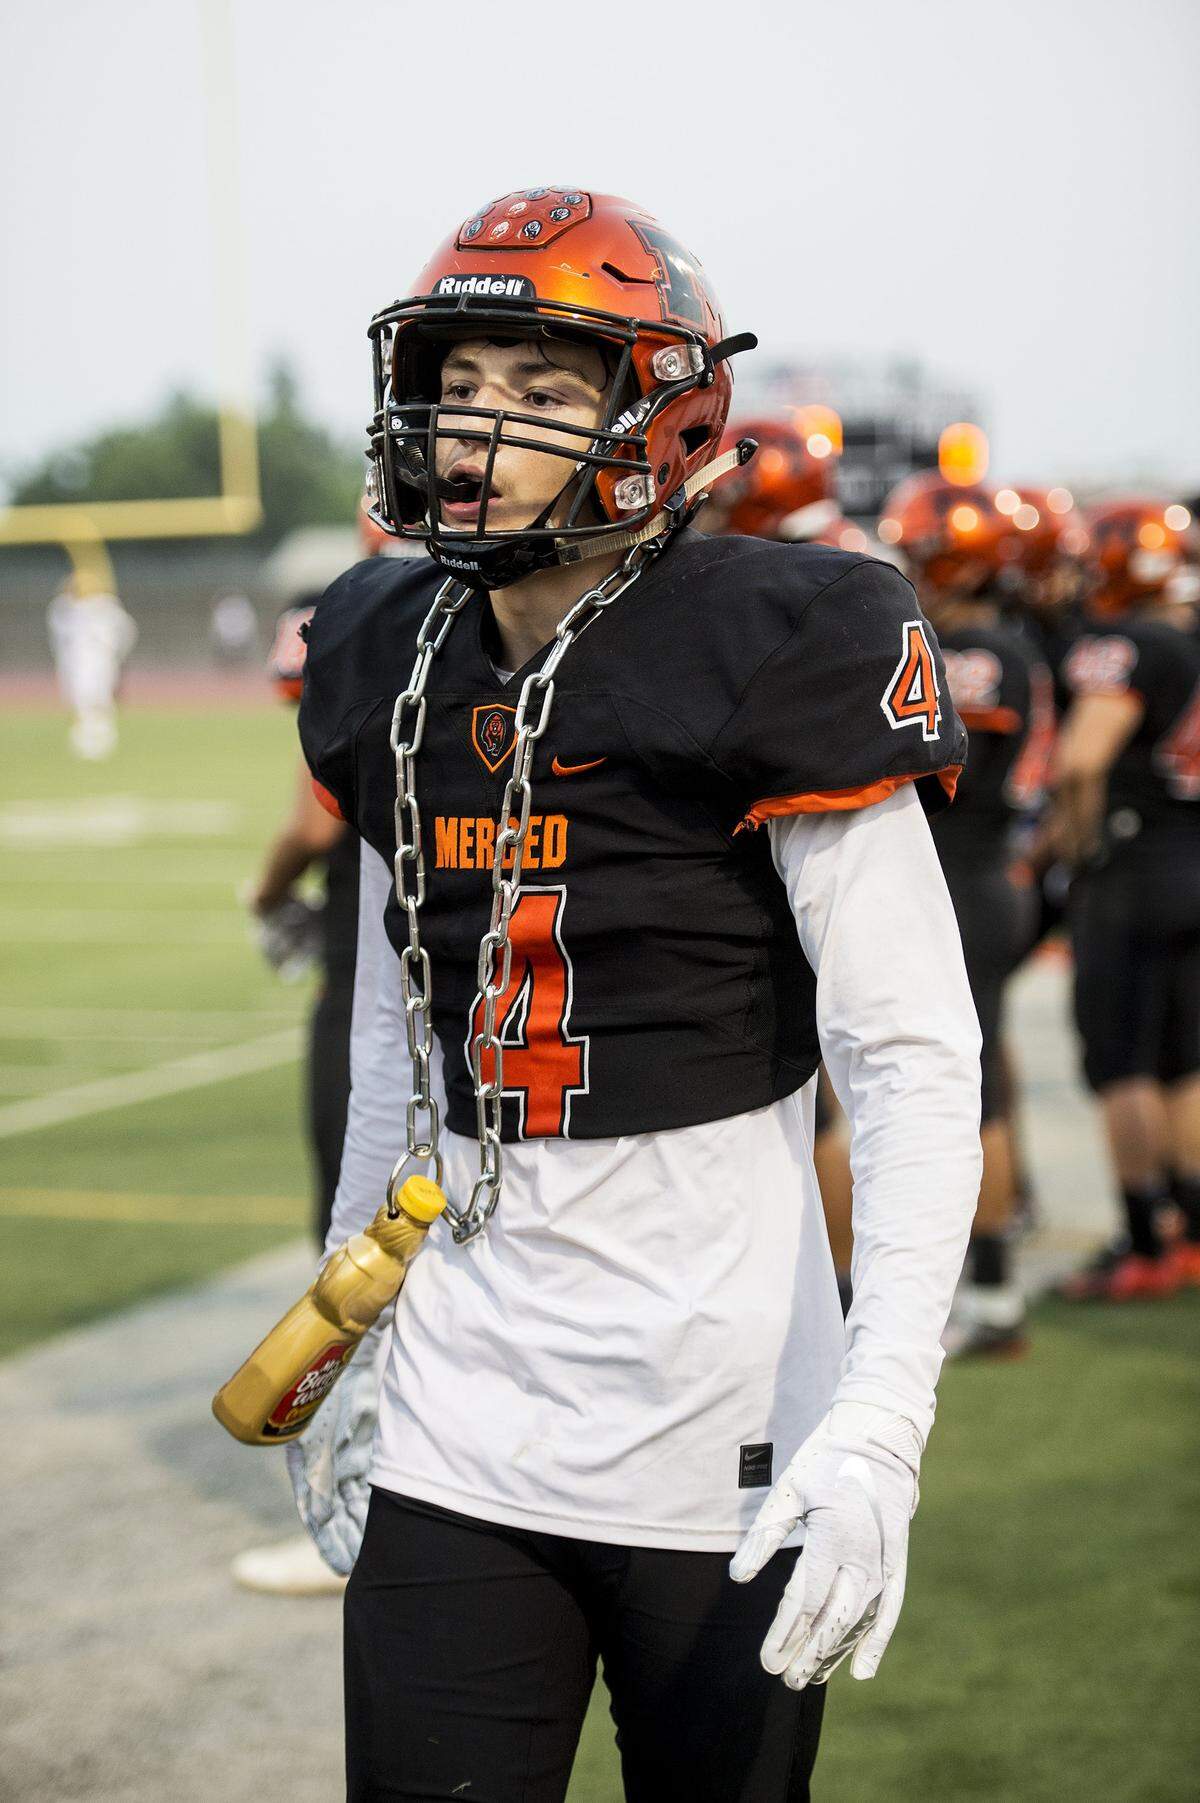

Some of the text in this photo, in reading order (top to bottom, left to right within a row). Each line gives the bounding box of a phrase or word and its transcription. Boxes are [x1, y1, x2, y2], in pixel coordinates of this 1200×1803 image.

[438, 277, 525, 297] Riddell
[439, 554, 480, 571] Riddell
[880, 620, 942, 742] 4
[464, 885, 590, 1141] 4
